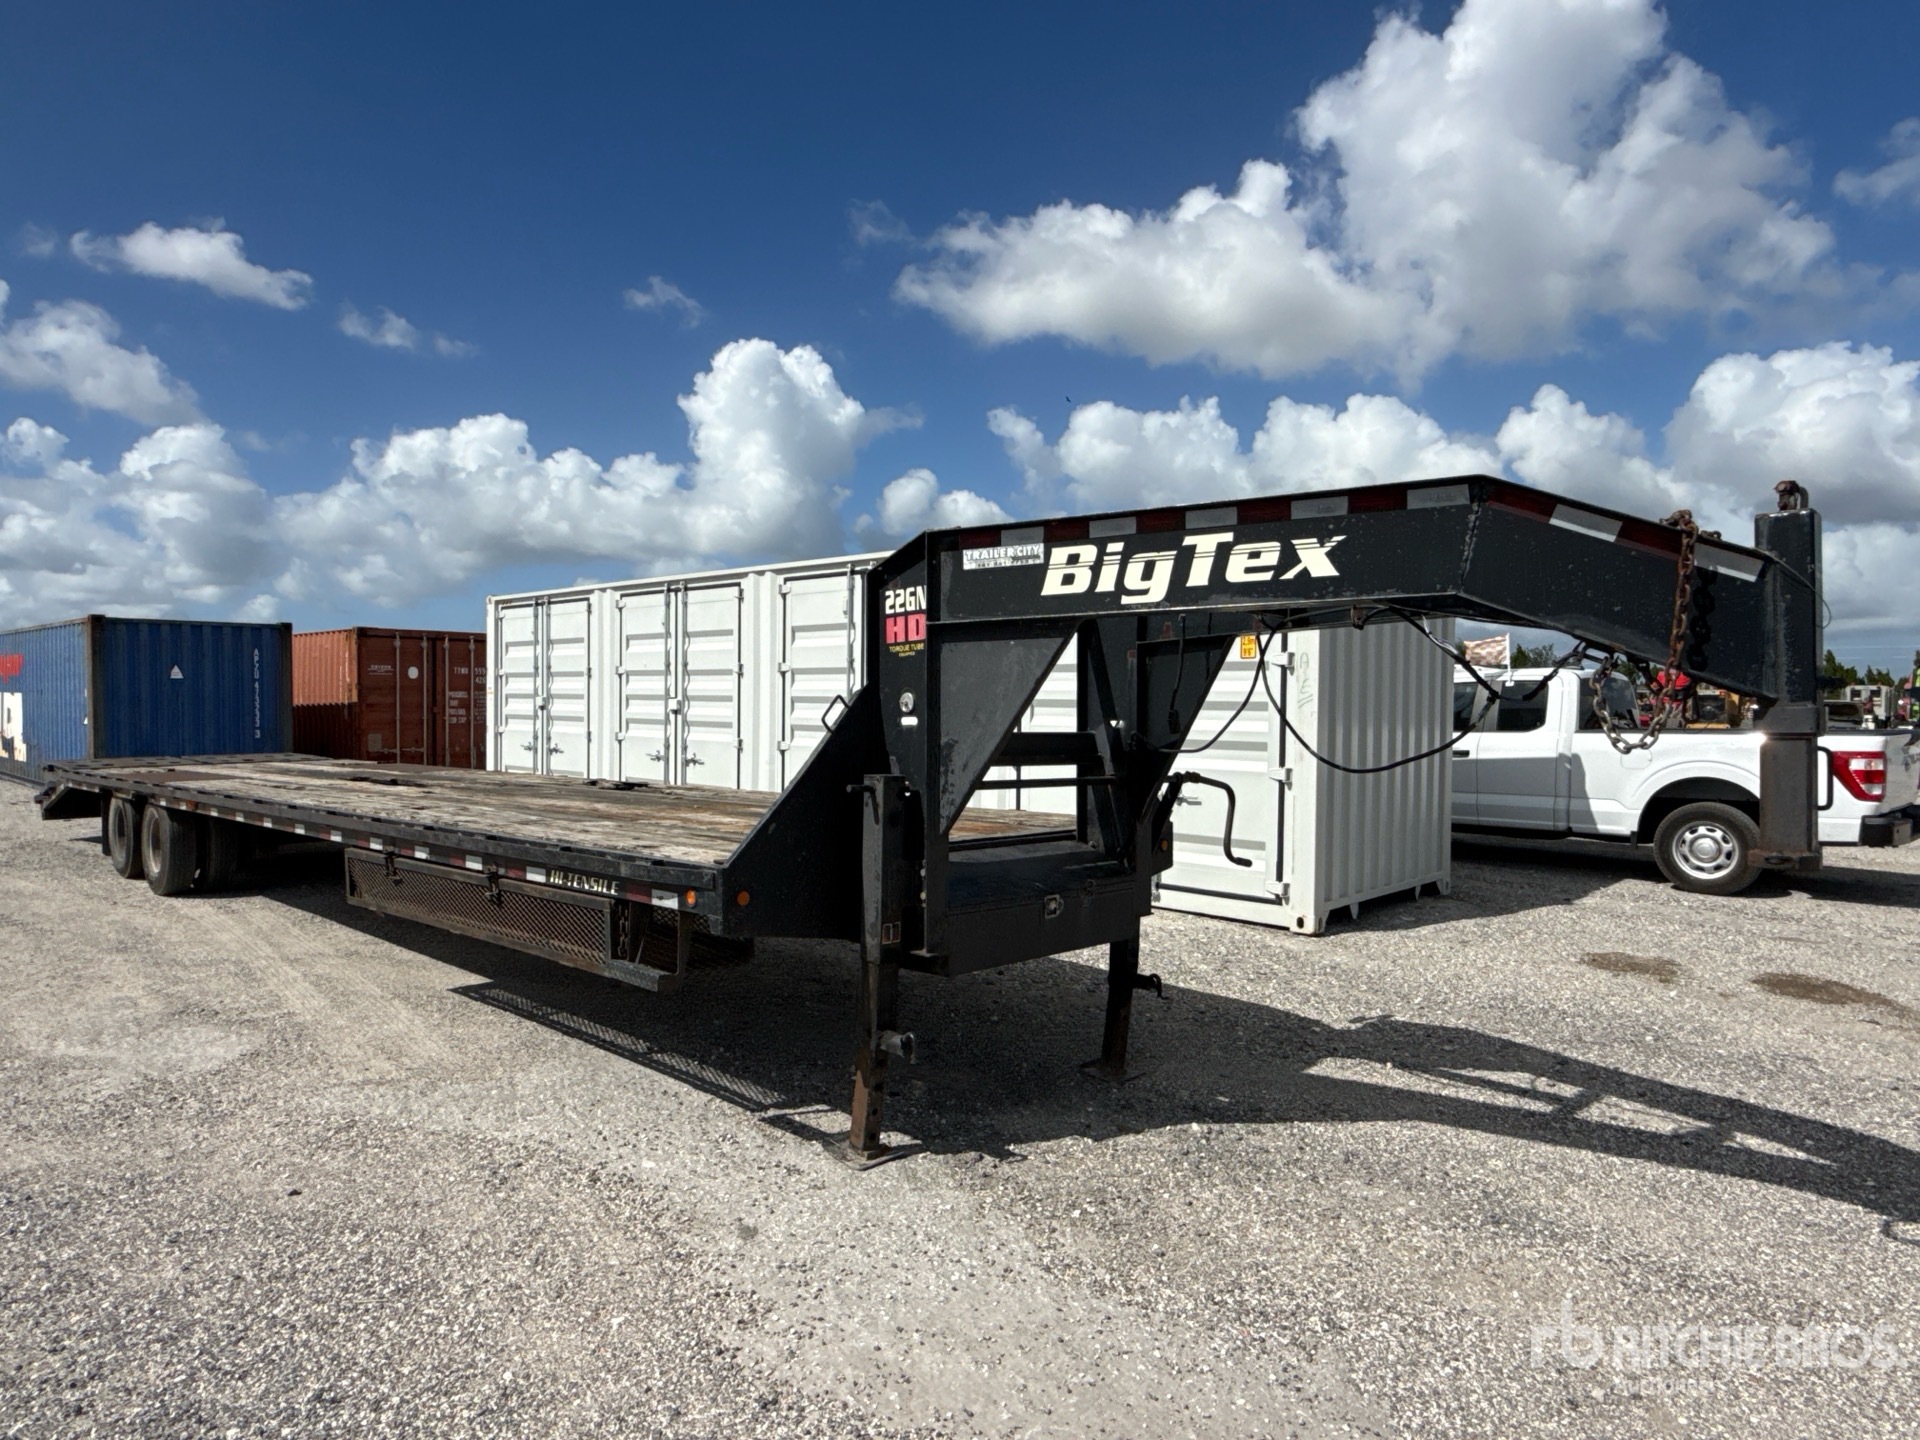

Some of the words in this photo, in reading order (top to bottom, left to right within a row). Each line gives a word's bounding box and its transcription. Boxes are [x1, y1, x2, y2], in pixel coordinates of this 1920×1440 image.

[966, 547, 1014, 560] TRAILER
[1016, 545, 1040, 557] CITY
[885, 585, 927, 614] 22GN
[886, 613, 927, 644] HD
[550, 869, 621, 895] HI-TENSILE
